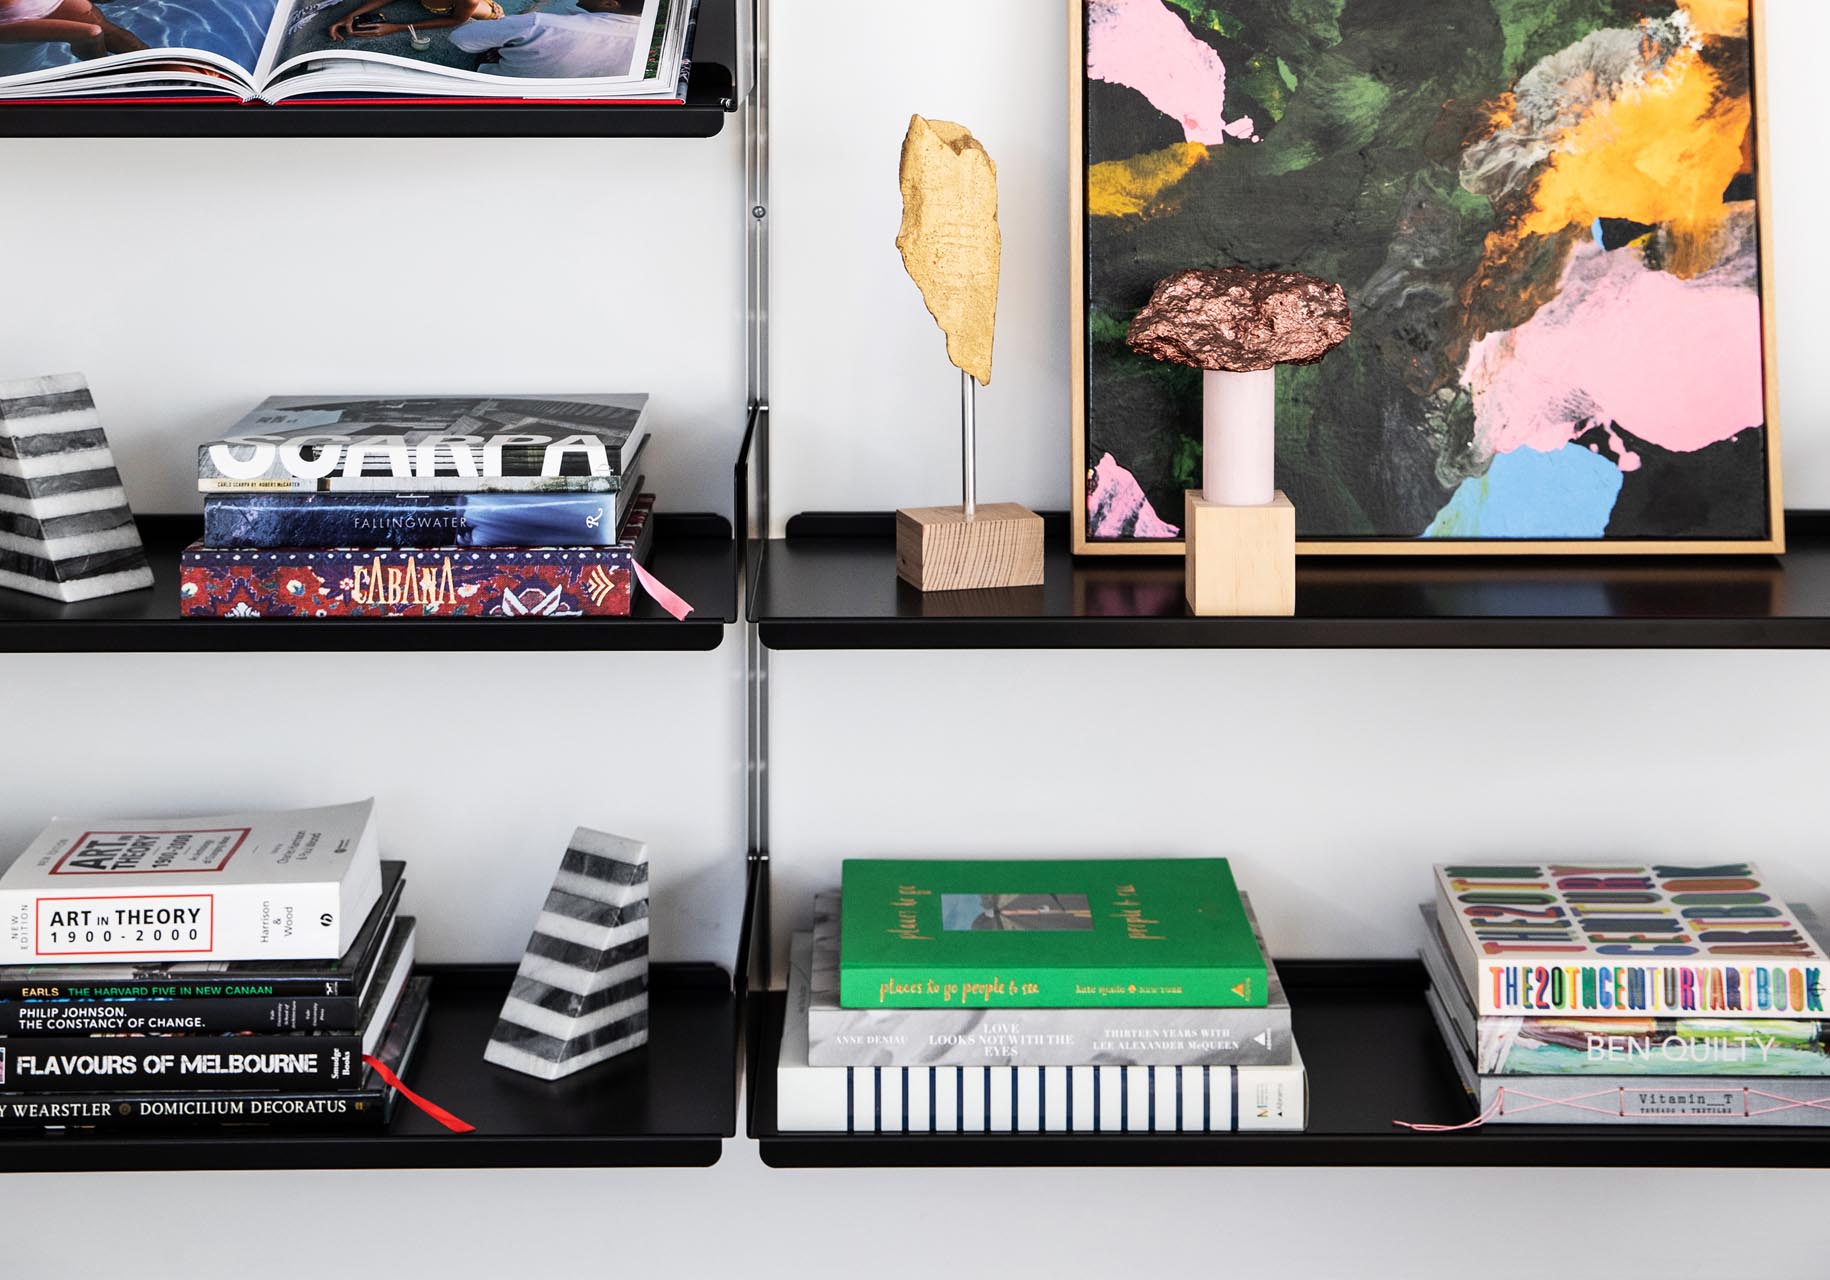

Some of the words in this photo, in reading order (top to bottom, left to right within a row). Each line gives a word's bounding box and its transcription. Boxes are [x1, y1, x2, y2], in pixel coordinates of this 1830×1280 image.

[354, 517, 468, 528] FALLINGWATER
[353, 556, 457, 604] CABANA
[69, 840, 128, 870] ART
[111, 835, 161, 870] THEORY
[50, 911, 92, 926] ART
[97, 917, 109, 926] IN
[115, 908, 201, 925] THEORY
[260, 900, 270, 943] Harrison
[284, 906, 293, 937] Wood
[11, 915, 19, 940] NEW
[21, 904, 29, 950] EDITION
[22, 987, 60, 997] EARLS
[68, 987, 91, 997] THE
[94, 987, 149, 997] HARVARD
[152, 987, 177, 996] FIVE
[180, 986, 192, 996] IN
[195, 986, 221, 996] NEW
[225, 985, 273, 995] CANAAN
[879, 977, 923, 1003] places
[943, 983, 958, 1002] go
[961, 976, 1005, 1003] people
[1021, 982, 1039, 995] see
[19, 1008, 59, 1019] PHILIP
[61, 1007, 127, 1019] JOHNSON.
[19, 1020, 44, 1030] THE
[46, 1019, 125, 1030] CONSTANCY
[128, 1018, 145, 1029] OF
[148, 1017, 206, 1029] CHANGE.
[984, 1024, 1020, 1034] LOVE
[835, 1035, 866, 1045] ANNE
[929, 1035, 975, 1045] LOOKS
[978, 1035, 1009, 1045] NOT
[1011, 1035, 1043, 1045] WITH
[1046, 1035, 1074, 1045] THE
[1105, 1029, 1159, 1039] THIRTEEN
[1162, 1029, 1197, 1039] YEARS
[1200, 1029, 1230, 1039] WITH
[984, 1047, 1019, 1057] EYES
[1093, 1041, 1112, 1051] LEE
[1115, 1041, 1184, 1051] ALEXANDER
[1188, 1041, 1239, 1051] McQUEEN
[1587, 1036, 1650, 1061] BEN
[1661, 1035, 1776, 1062] QUILTY
[17, 1055, 137, 1075] FLAVOURS
[143, 1055, 175, 1075] OF
[180, 1053, 318, 1074] MELBOURNE
[331, 1048, 342, 1080] Smudge
[342, 1051, 351, 1076] Books
[14, 1104, 111, 1118] WEARSTLER
[140, 1102, 243, 1116] DOMICILIUM
[250, 1100, 347, 1114] DECORATUS
